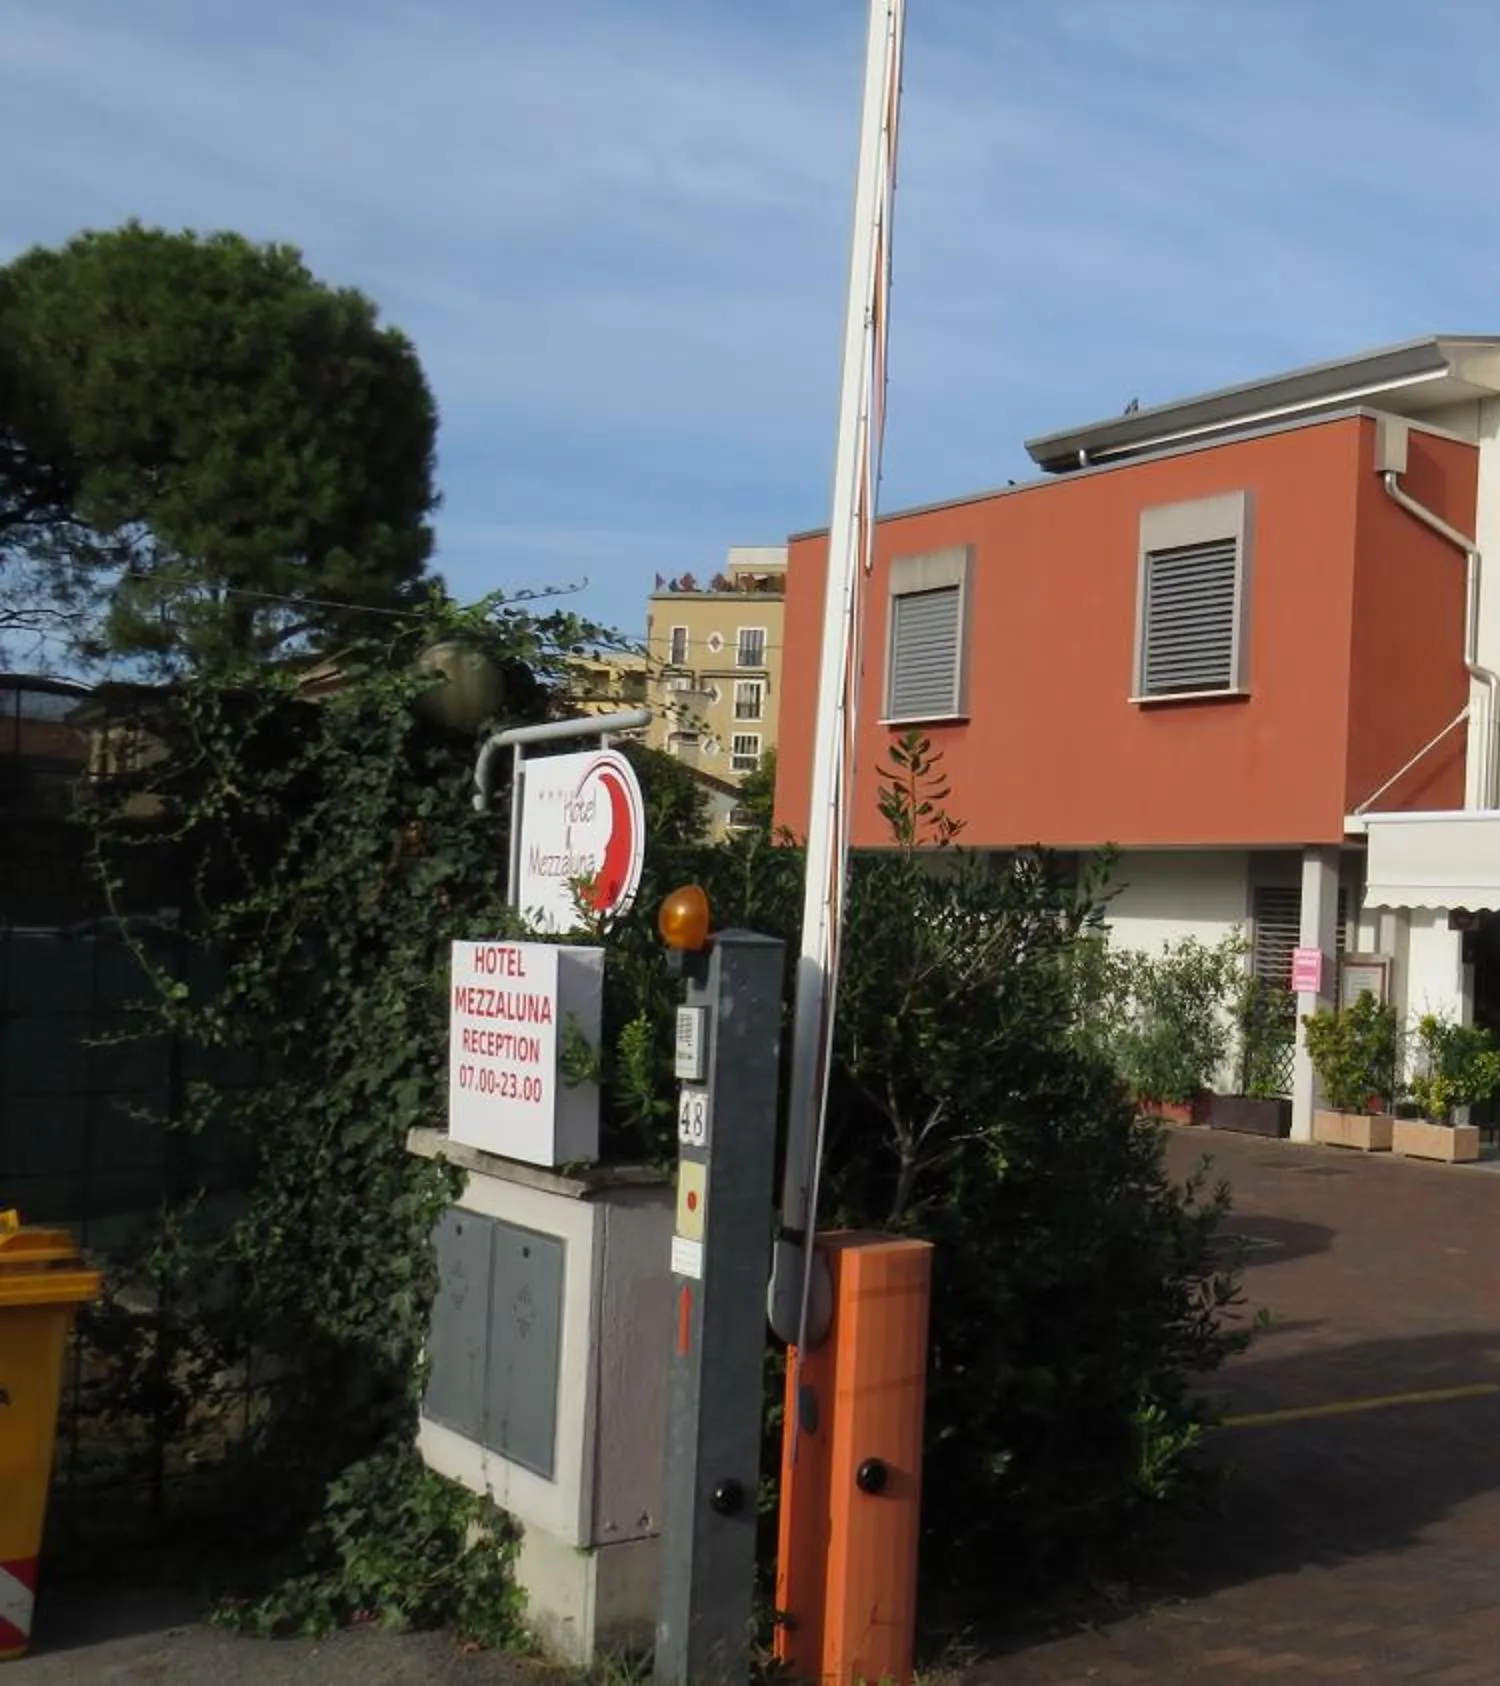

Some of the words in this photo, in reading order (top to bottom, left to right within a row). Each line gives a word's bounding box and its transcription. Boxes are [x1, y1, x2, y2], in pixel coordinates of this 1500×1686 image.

[562, 787, 597, 824] Hotel
[528, 843, 596, 877] Mezzaluna
[473, 945, 526, 977] HOTEL
[454, 986, 553, 1025] MEZZALUNA
[462, 1027, 541, 1063] RECEPTION
[459, 1063, 543, 1103] 07.00-23.00
[680, 1101, 703, 1137] 48
